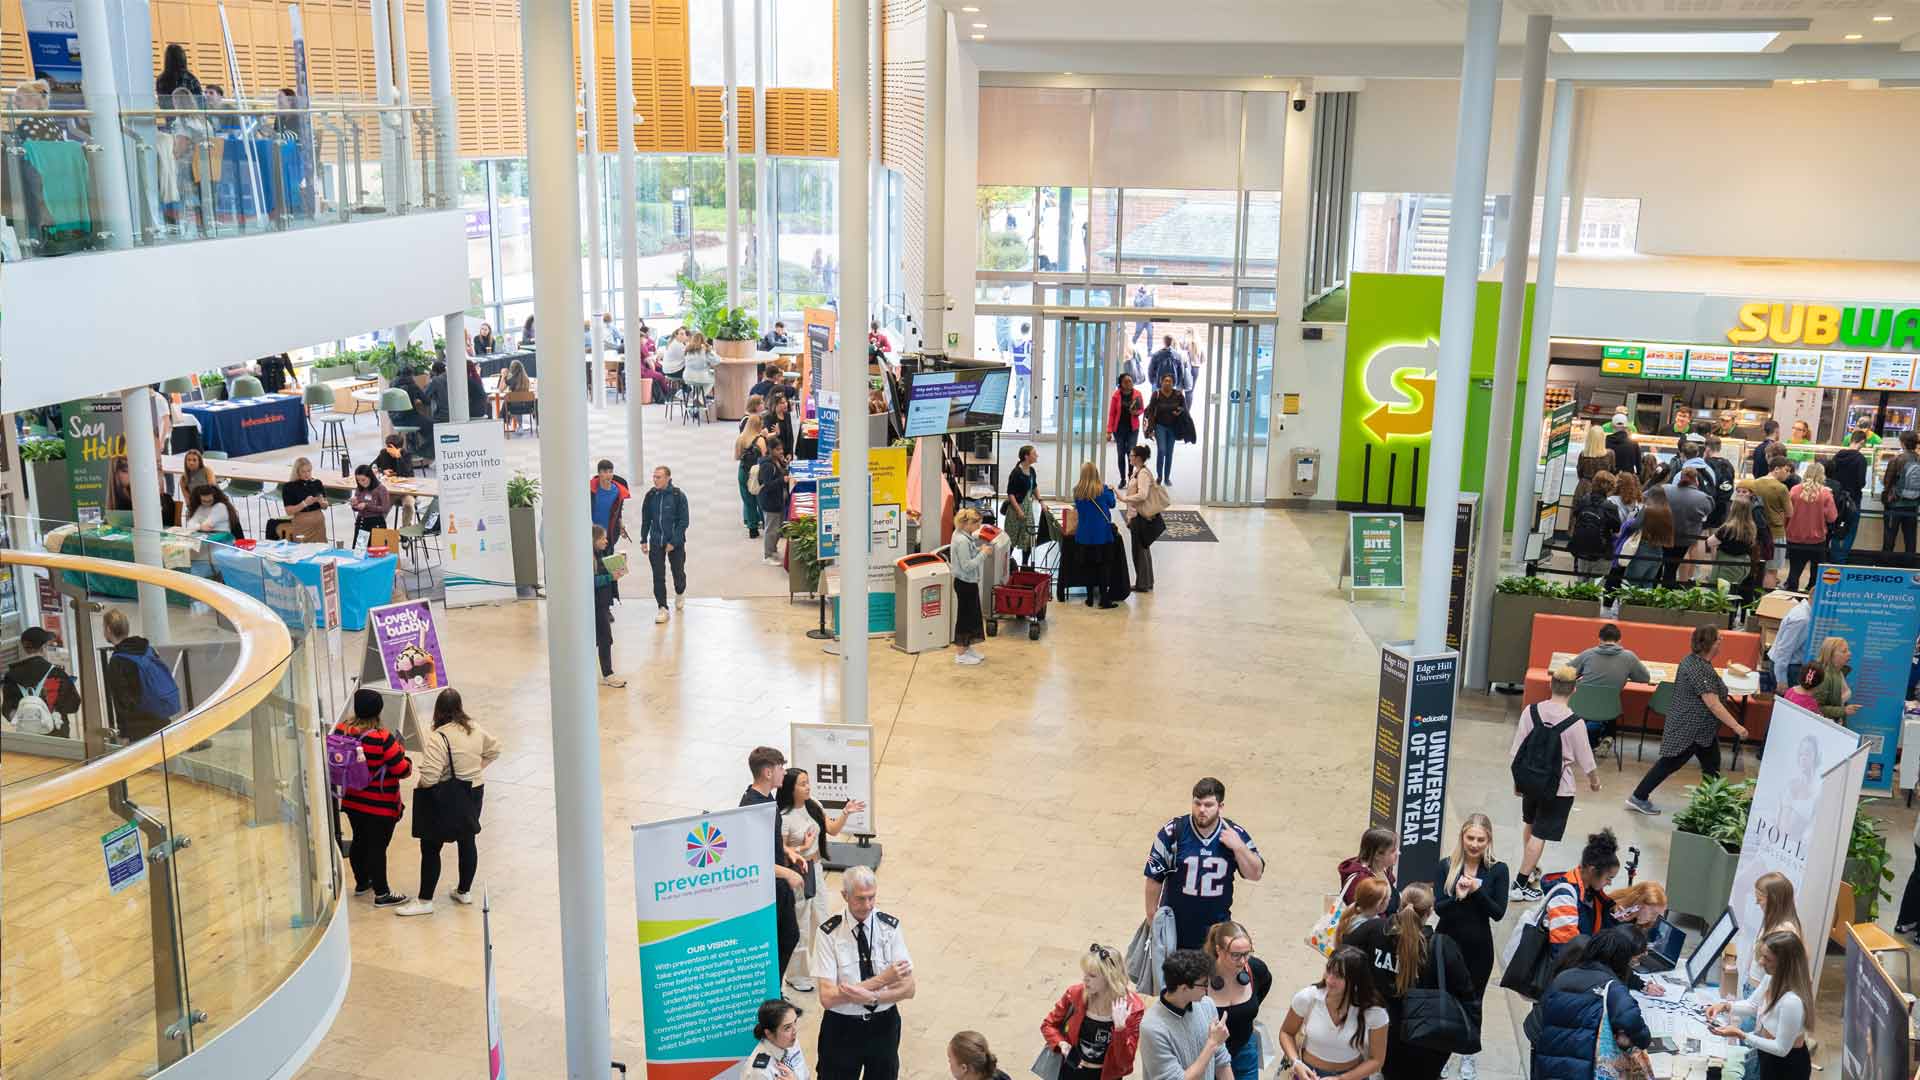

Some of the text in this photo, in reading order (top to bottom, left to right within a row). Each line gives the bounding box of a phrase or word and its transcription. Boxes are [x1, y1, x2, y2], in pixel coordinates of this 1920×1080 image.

[69, 416, 106, 445] Say
[82, 431, 128, 461] Hell
[441, 448, 487, 461] Turn your
[443, 458, 501, 472] passion into
[451, 471, 481, 480] career
[1847, 574, 1904, 584] PEPSICO
[1826, 590, 1861, 598] Careers
[1877, 592, 1914, 602] PepsiCo
[375, 608, 419, 627] Lovely
[386, 617, 430, 637] bubbly
[1384, 653, 1408, 671] Edge Hill
[1416, 661, 1453, 674] Edge Hill
[1383, 663, 1407, 681] University
[1416, 673, 1451, 682] University
[1422, 714, 1449, 723] educate
[816, 763, 848, 784] EH
[1402, 732, 1427, 846] OF THE YEAR
[1422, 730, 1448, 842] UNIVERSITY
[654, 863, 760, 902] prevention
[1182, 855, 1228, 897] 12
[687, 939, 738, 954] OUR VISION:
[655, 963, 672, 971] With
[672, 955, 709, 969] prevention
[673, 968, 692, 976] every
[693, 960, 734, 972] opportunity
[743, 952, 768, 964] prevent
[655, 981, 675, 989] crime
[675, 975, 698, 985] before
[704, 968, 737, 978] happens.
[737, 961, 765, 972] Working
[726, 973, 753, 983] address
[663, 993, 699, 1006] underlying
[700, 988, 723, 998] causes
[733, 981, 752, 990] crime
[753, 976, 766, 986] and
[706, 996, 730, 1004] reduce
[751, 987, 767, 996] stop
[711, 1005, 725, 1013] and
[725, 999, 752, 1010] support
[655, 1021, 698, 1034] communities
[698, 1018, 708, 1026] by
[708, 1012, 734, 1022] making
[660, 1033, 684, 1042] better
[684, 1029, 702, 1040] place
[726, 1020, 742, 1028] work
[743, 1015, 756, 1023] and
[657, 1041, 679, 1050] whilst
[679, 1036, 705, 1047] building
[705, 1032, 720, 1040] trust
[720, 1028, 737, 1036] and
